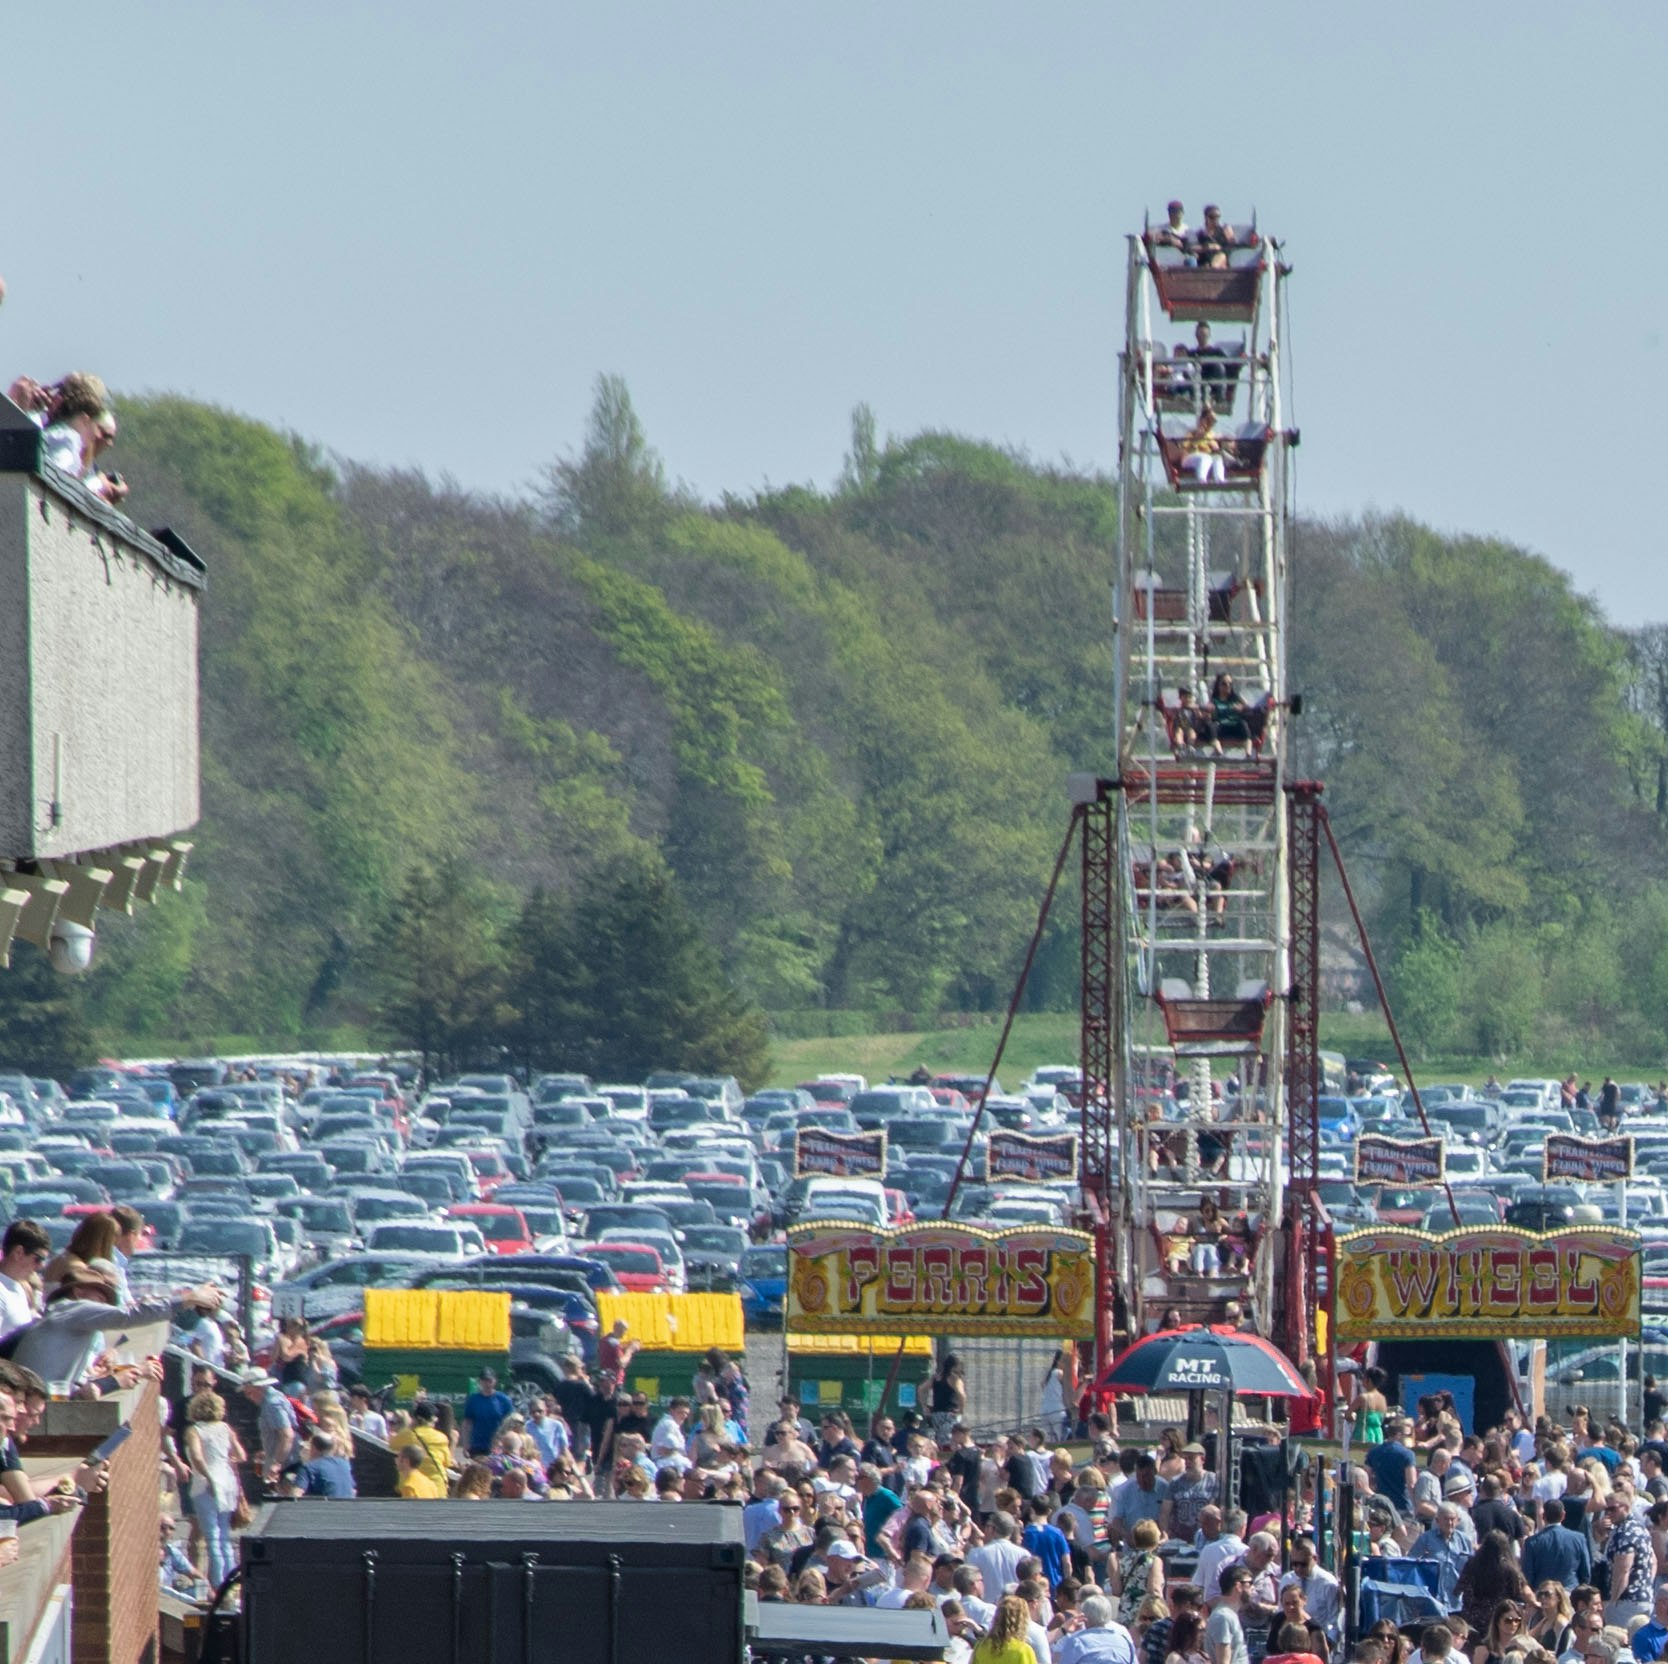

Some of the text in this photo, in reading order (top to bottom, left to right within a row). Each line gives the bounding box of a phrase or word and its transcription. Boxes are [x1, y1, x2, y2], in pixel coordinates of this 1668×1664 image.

[842, 1247, 1049, 1312] FERRIS
[1384, 1249, 1601, 1314] WHEEL
[1168, 1372, 1222, 1384] RACING
[1175, 1358, 1217, 1373] MT
